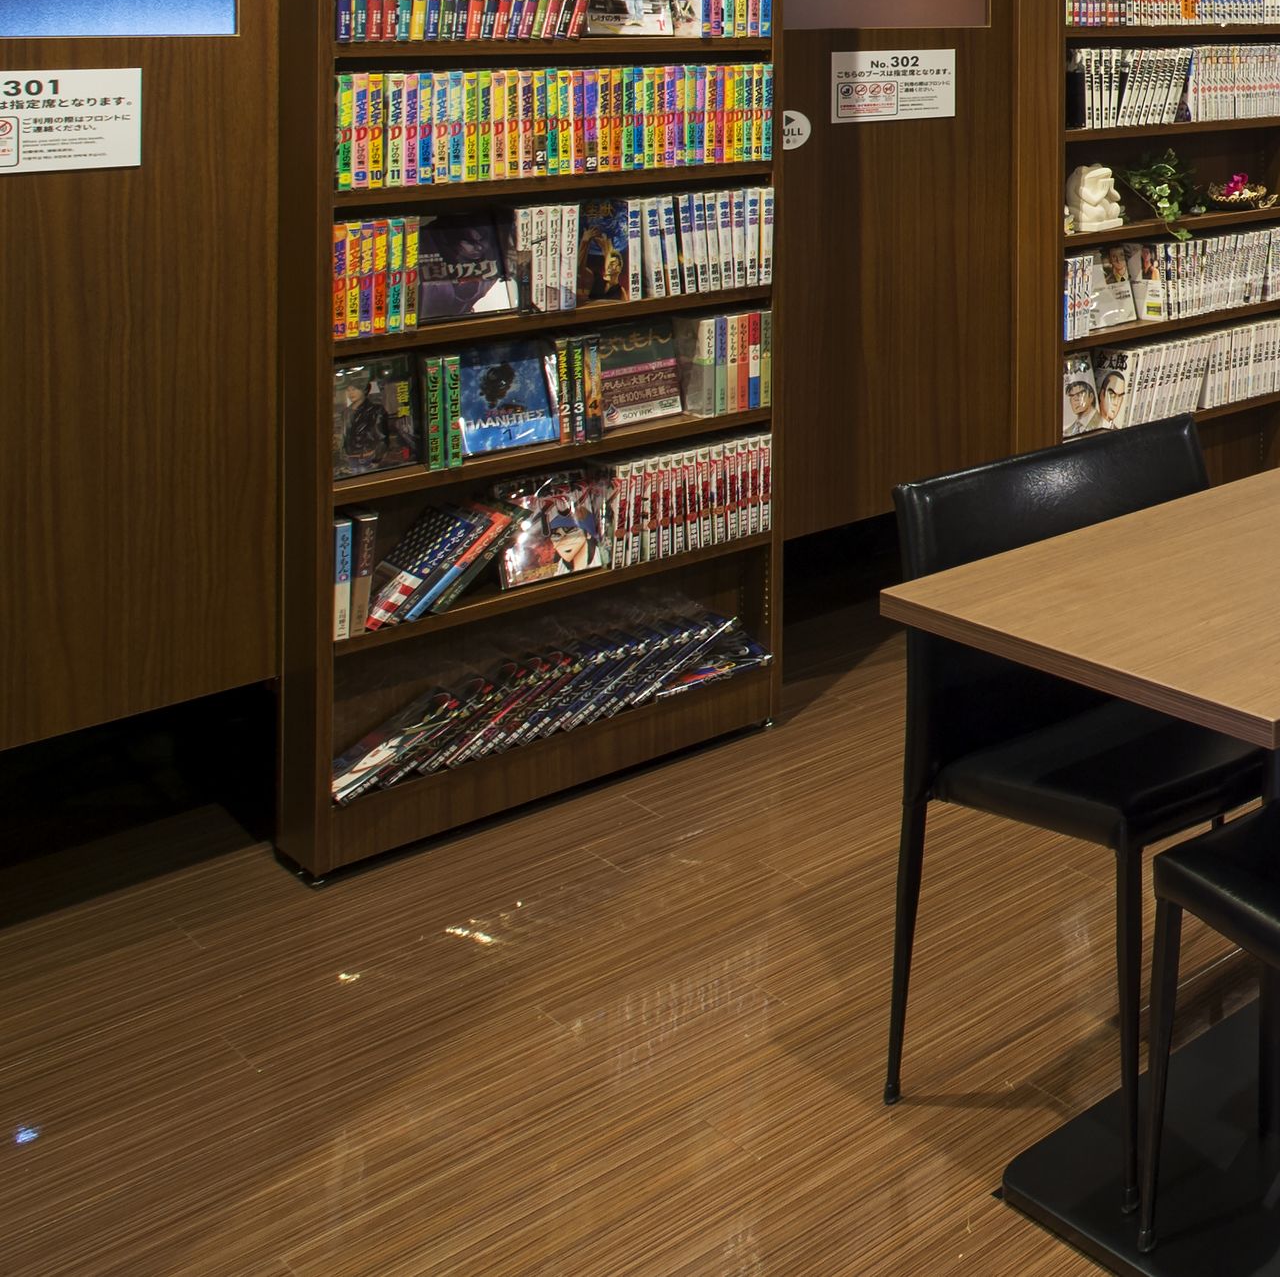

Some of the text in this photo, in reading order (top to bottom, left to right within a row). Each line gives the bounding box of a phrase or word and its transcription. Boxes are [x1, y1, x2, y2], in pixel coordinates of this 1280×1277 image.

[837, 69, 951, 79] こちらのブースは指定席となります。
[4, 79, 59, 96] 301
[23, 114, 131, 125] ご利用の際はフロントに
[23, 124, 96, 133] ご連絡ください。
[783, 127, 803, 136] ULL
[481, 164, 490, 173] 17
[509, 161, 519, 171] 19
[522, 161, 533, 170] 20
[355, 172, 367, 181] 9
[371, 171, 382, 180] 10
[390, 169, 400, 180] 11
[406, 169, 417, 179] 12
[405, 313, 416, 325] 48
[561, 404, 571, 415] 2
[574, 403, 584, 413] 3
[589, 400, 598, 410] 4
